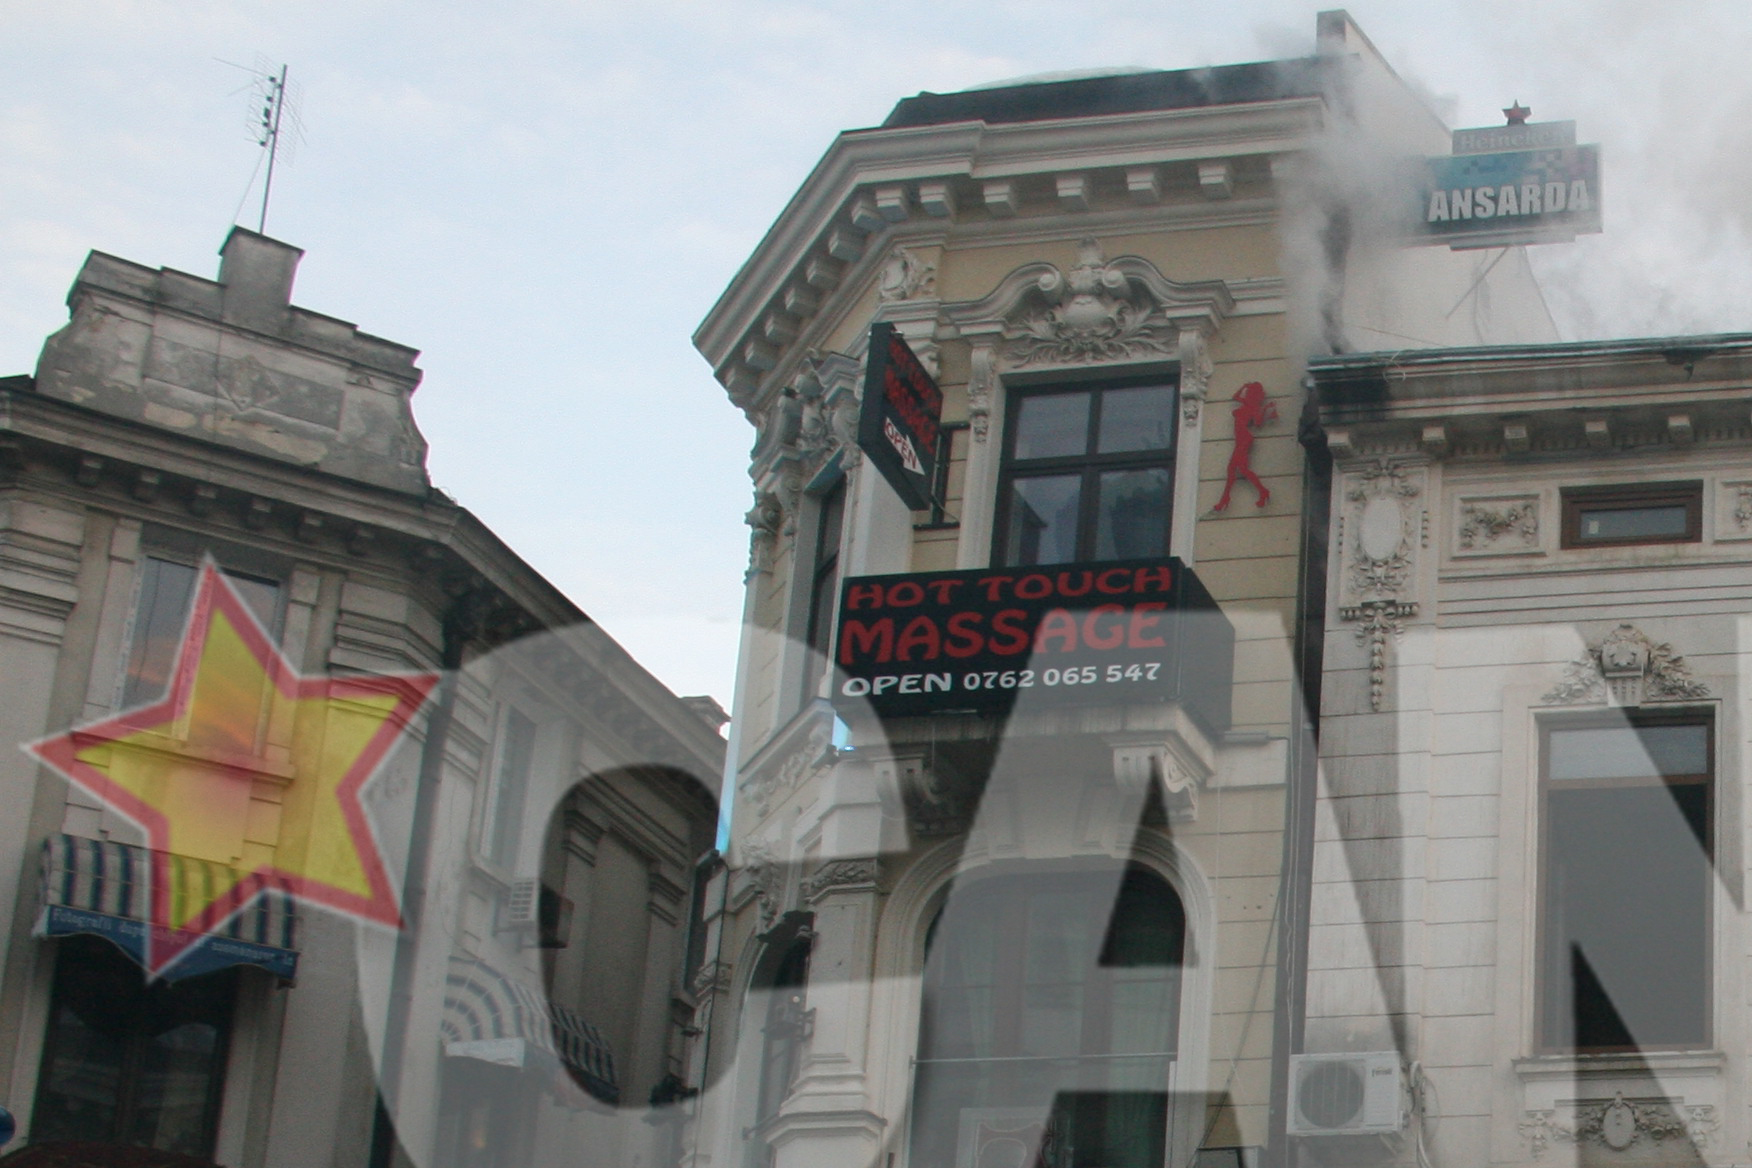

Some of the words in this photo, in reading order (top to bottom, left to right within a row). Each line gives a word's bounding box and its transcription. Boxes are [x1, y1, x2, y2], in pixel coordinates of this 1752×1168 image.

[884, 422, 918, 470] OPEN
[846, 580, 965, 611] HOT
[977, 566, 1173, 600] TOUCH
[838, 602, 1168, 666] MASSAGE
[841, 673, 952, 697] OPEN
[963, 669, 1035, 691] 0762
[1042, 665, 1099, 687] 065
[1105, 662, 1162, 684] 547
